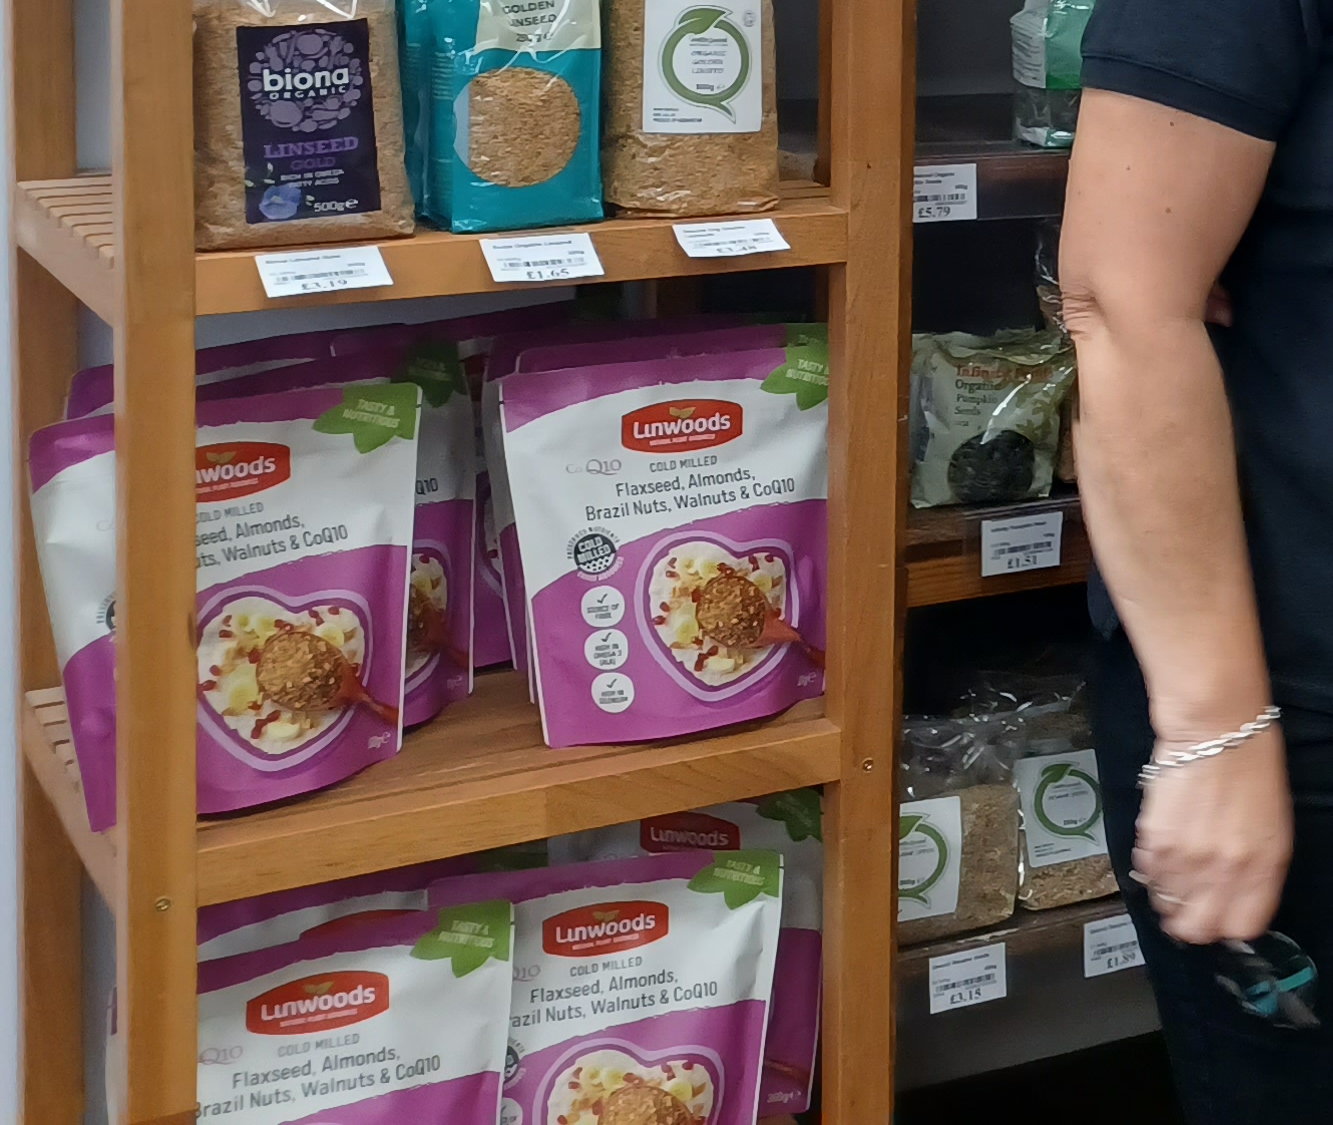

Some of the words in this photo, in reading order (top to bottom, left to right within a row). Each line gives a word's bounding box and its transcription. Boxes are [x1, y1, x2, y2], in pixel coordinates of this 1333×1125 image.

[502, 0, 555, 14] GOLDEN
[263, 67, 349, 92] biona
[269, 85, 347, 100] ORGANIC
[263, 136, 359, 159] LINSEED
[290, 156, 336, 171] GOLD
[917, 206, 951, 219] £5.79
[526, 268, 570, 280] £1.65
[633, 412, 731, 440] Linwoods
[649, 459, 677, 473] COLD
[679, 455, 718, 470] MILLED
[615, 475, 685, 498] Flaxseed,
[688, 467, 756, 489] Almonds,
[223, 502, 265, 519] MILLED
[585, 502, 630, 522] Brazil
[633, 497, 672, 516] Nuts,
[674, 486, 737, 510] Walnuts
[740, 484, 750, 500] &
[752, 476, 795, 497] CoQ10
[234, 513, 305, 540] Almonds,
[221, 538, 287, 563] Walnuts
[289, 533, 300, 551] &
[302, 524, 349, 548] CoQ10
[1007, 555, 1038, 569] £1.51
[650, 826, 730, 847] Linwoods
[556, 912, 656, 945] Linwoods
[569, 962, 600, 978] COLD
[602, 956, 643, 973] MILLED
[530, 978, 605, 1004] Flaxseed,
[609, 969, 679, 993] Almonds,
[949, 988, 982, 1005] £3.15
[261, 984, 376, 1021] Linwoods
[545, 1002, 587, 1025] Nuts,
[591, 992, 656, 1018] Walnuts
[659, 988, 670, 1004] &
[673, 981, 718, 1004] CoQ10
[277, 1040, 310, 1057] COLD
[315, 1033, 360, 1050] MILLED
[232, 1061, 316, 1090] Flaxseed,
[321, 1046, 400, 1073] Almonds,
[250, 1086, 296, 1108] Nuts,
[301, 1069, 375, 1099] Walnuts
[380, 1067, 391, 1084] &
[395, 1054, 441, 1082] CoQ10
